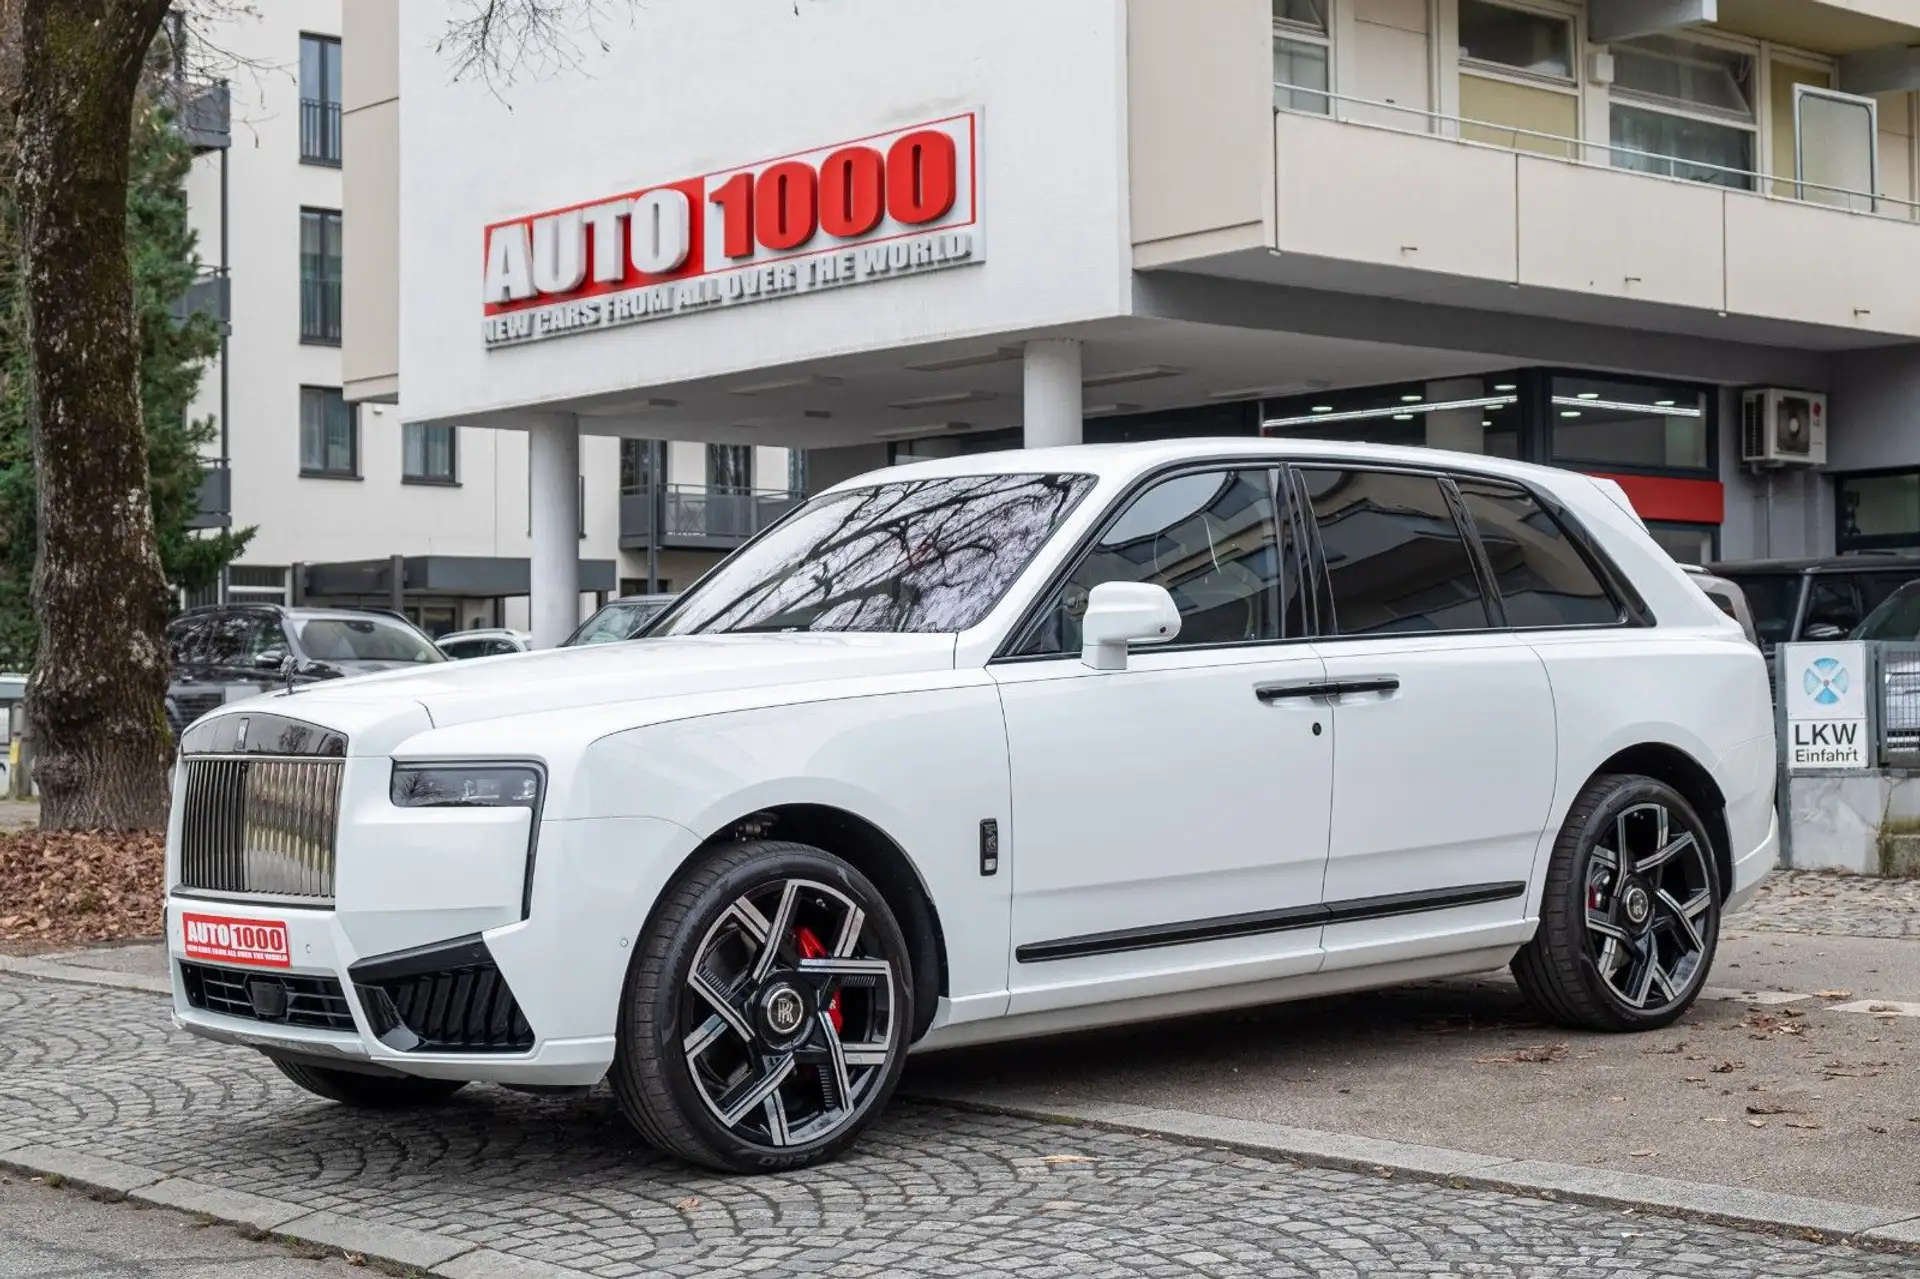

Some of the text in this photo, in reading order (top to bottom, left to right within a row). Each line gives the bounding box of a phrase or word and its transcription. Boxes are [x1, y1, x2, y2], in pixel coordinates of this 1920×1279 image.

[484, 129, 956, 304] AUTO 1000
[484, 232, 972, 344] NEW CARS FROM ALL OVER THE WORLD
[1795, 723, 1857, 746] LKW
[1795, 747, 1858, 763] Einfahrt
[186, 920, 283, 951] AUTO 1000
